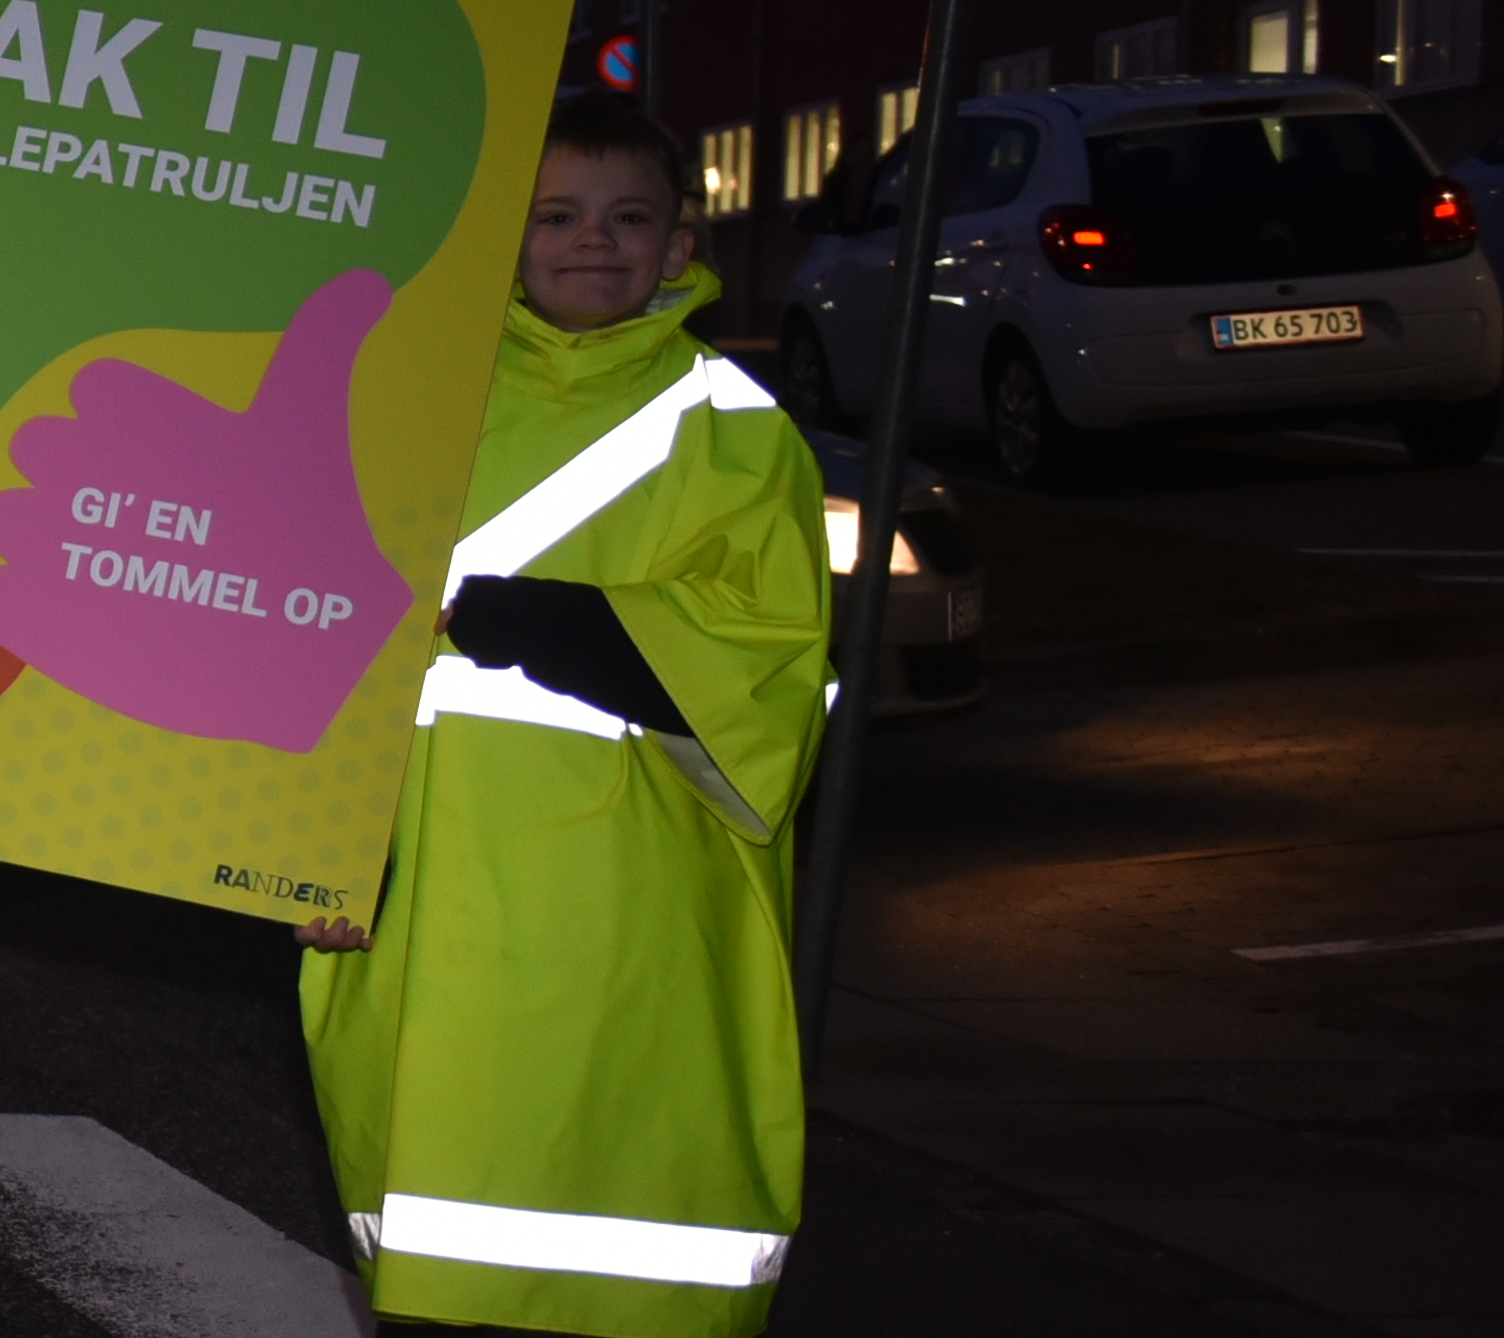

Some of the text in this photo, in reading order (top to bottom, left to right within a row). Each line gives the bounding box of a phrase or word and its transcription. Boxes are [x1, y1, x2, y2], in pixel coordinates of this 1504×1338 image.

[191, 27, 387, 160] TIL
[1232, 310, 1359, 341] BK 65 703
[144, 499, 213, 547] EN
[60, 541, 355, 631] TOMMEL OP
[213, 863, 350, 911] RANDERS
